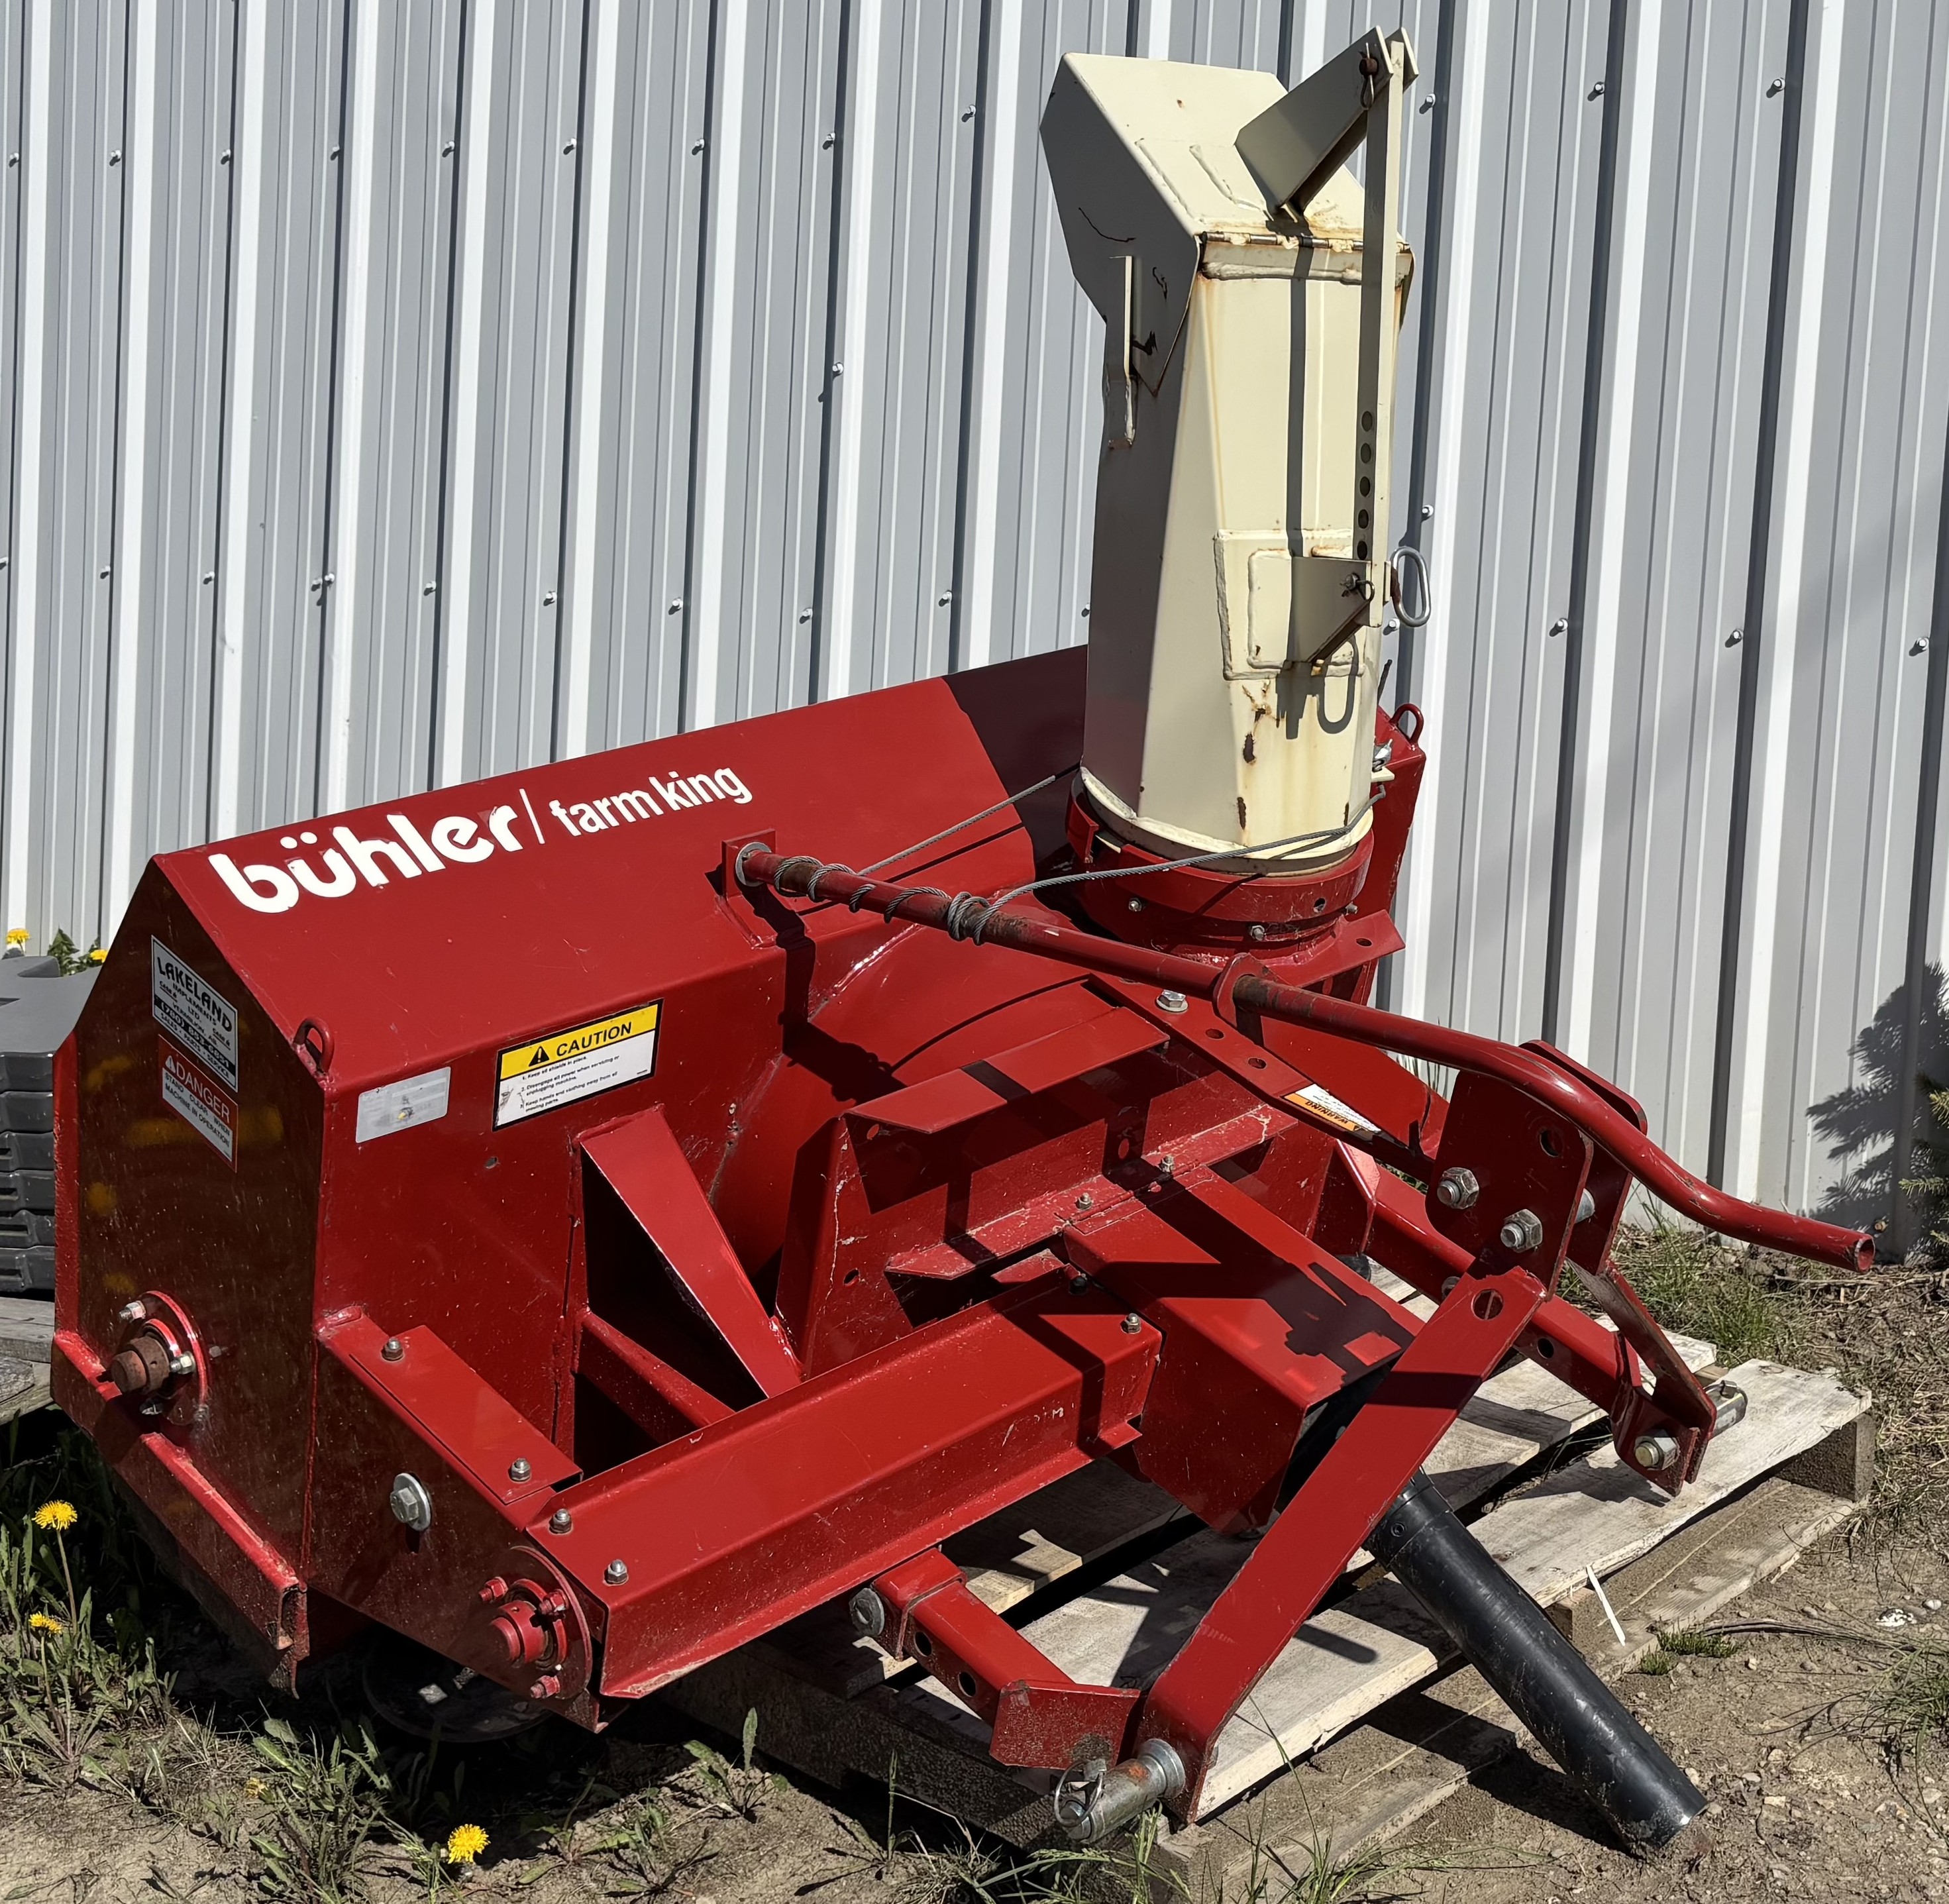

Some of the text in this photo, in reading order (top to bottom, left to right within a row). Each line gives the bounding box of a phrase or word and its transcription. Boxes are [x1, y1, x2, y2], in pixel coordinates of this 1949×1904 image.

[208, 768, 753, 914] bühler farm king
[157, 957, 233, 1031] LAKELAND
[161, 1002, 185, 1028] (780)
[173, 982, 216, 1026] IMPLEMENTS
[188, 1006, 201, 1022] LTD.
[161, 1012, 229, 1078] SALES PARTS SERVICE
[556, 1021, 631, 1057] CAUTION
[527, 1078, 553, 1090] Disengage
[560, 1070, 576, 1079] power
[549, 1063, 566, 1071] shields
[165, 1072, 230, 1136] STAND CLEAR WHEN
[176, 1061, 230, 1124] DANGER
[539, 1094, 554, 1102] hands
[165, 1083, 230, 1148] MACHINE IN OPERATION
